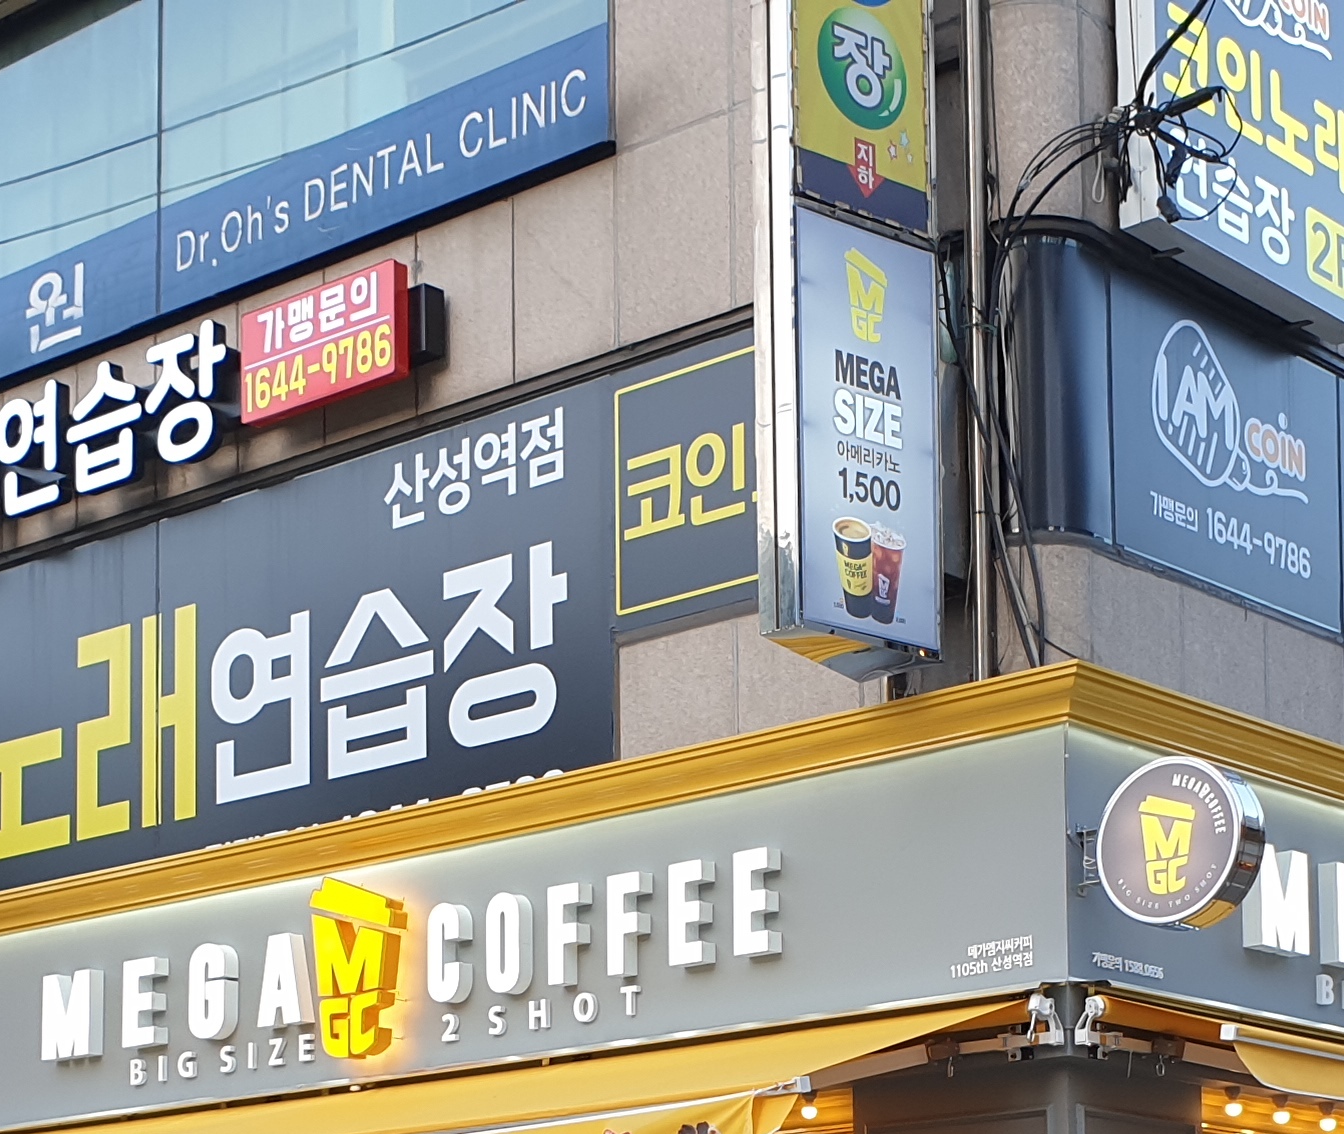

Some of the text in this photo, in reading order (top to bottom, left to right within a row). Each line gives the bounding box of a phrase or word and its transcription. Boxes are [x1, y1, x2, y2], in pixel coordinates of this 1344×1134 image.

[832, 21, 892, 110] 장
[304, 133, 444, 221] DENTAL
[458, 68, 587, 158] CLINIC
[857, 143, 875, 189] 지하
[1167, 127, 1296, 266] 연습장
[256, 271, 378, 353] 가맹문의
[244, 325, 392, 413] 1644-9786
[834, 349, 902, 400] MEGA
[832, 388, 903, 450] SIZE
[836, 439, 902, 475] 아메리카노
[383, 406, 565, 530] 산성역점
[837, 466, 901, 512] 1,500
[1150, 490, 1312, 579] 가맹문의 1644-9786
[41, 846, 783, 1063] MEGA COFFEE
[950, 951, 1034, 981] 1105th 산성역점
[129, 985, 642, 1087] BIG SIZE 2 SHOT
